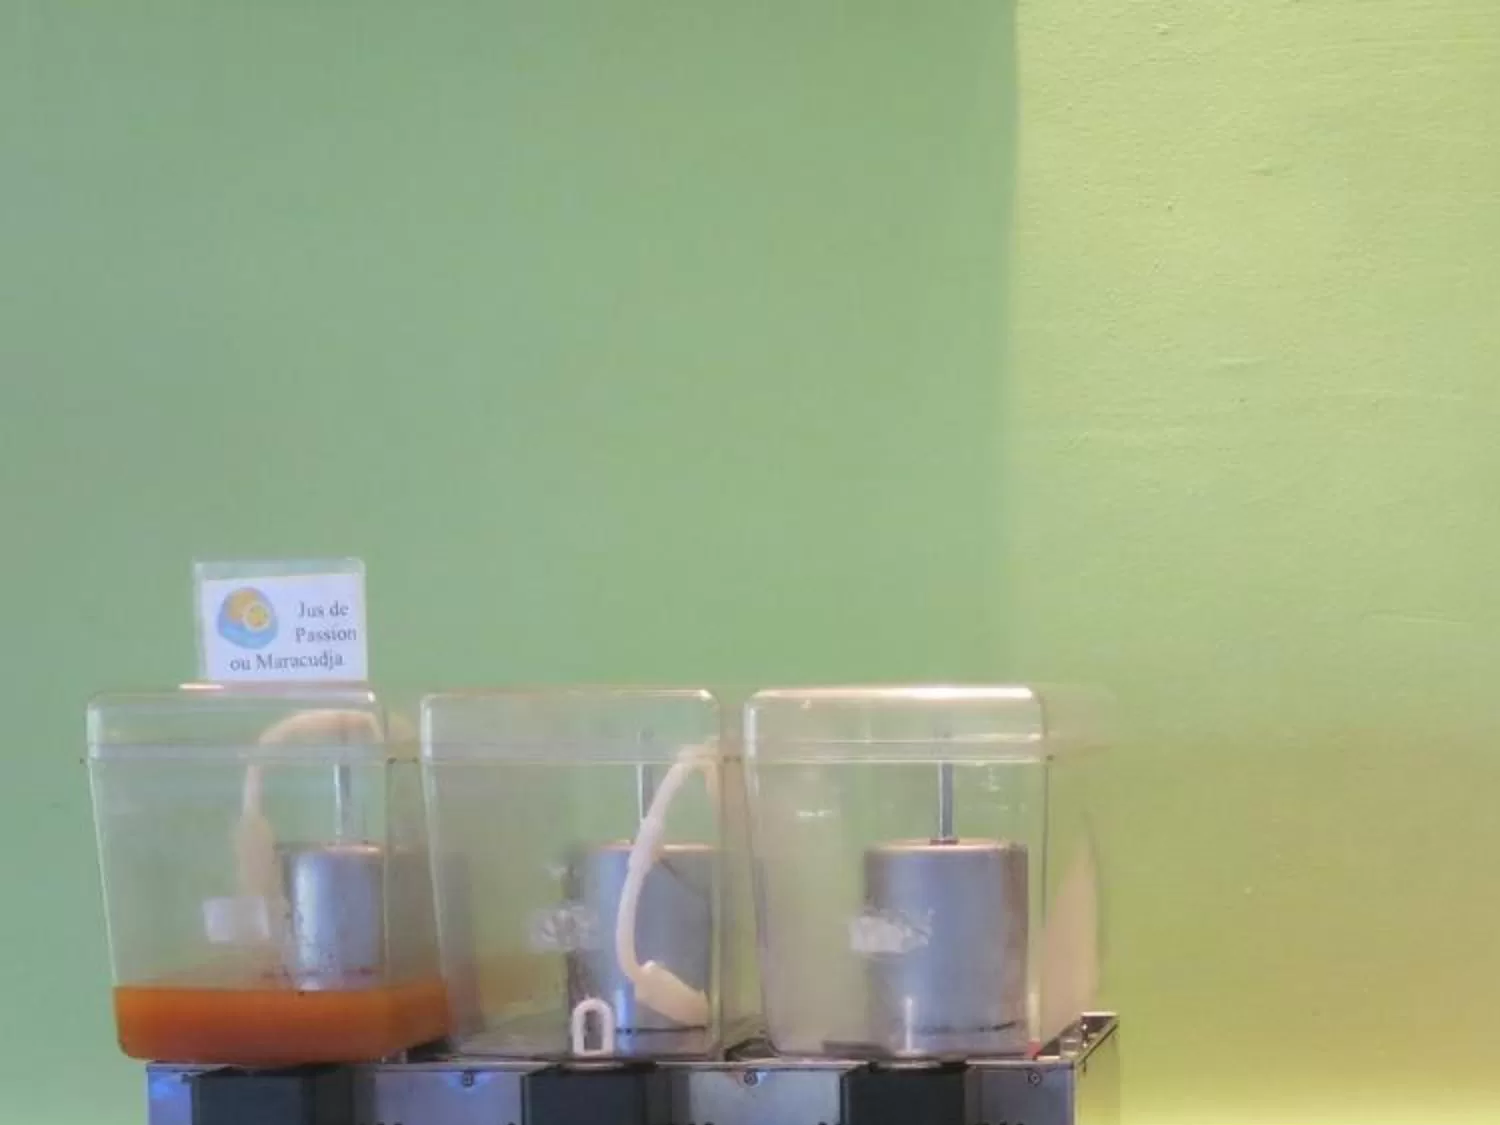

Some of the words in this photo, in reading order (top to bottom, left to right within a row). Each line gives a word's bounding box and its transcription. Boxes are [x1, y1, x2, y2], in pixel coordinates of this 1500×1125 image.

[298, 602, 325, 618] Jus
[329, 601, 349, 617] de
[295, 627, 357, 643] Passion
[229, 658, 251, 671] ou
[255, 650, 343, 671] Maracudja
